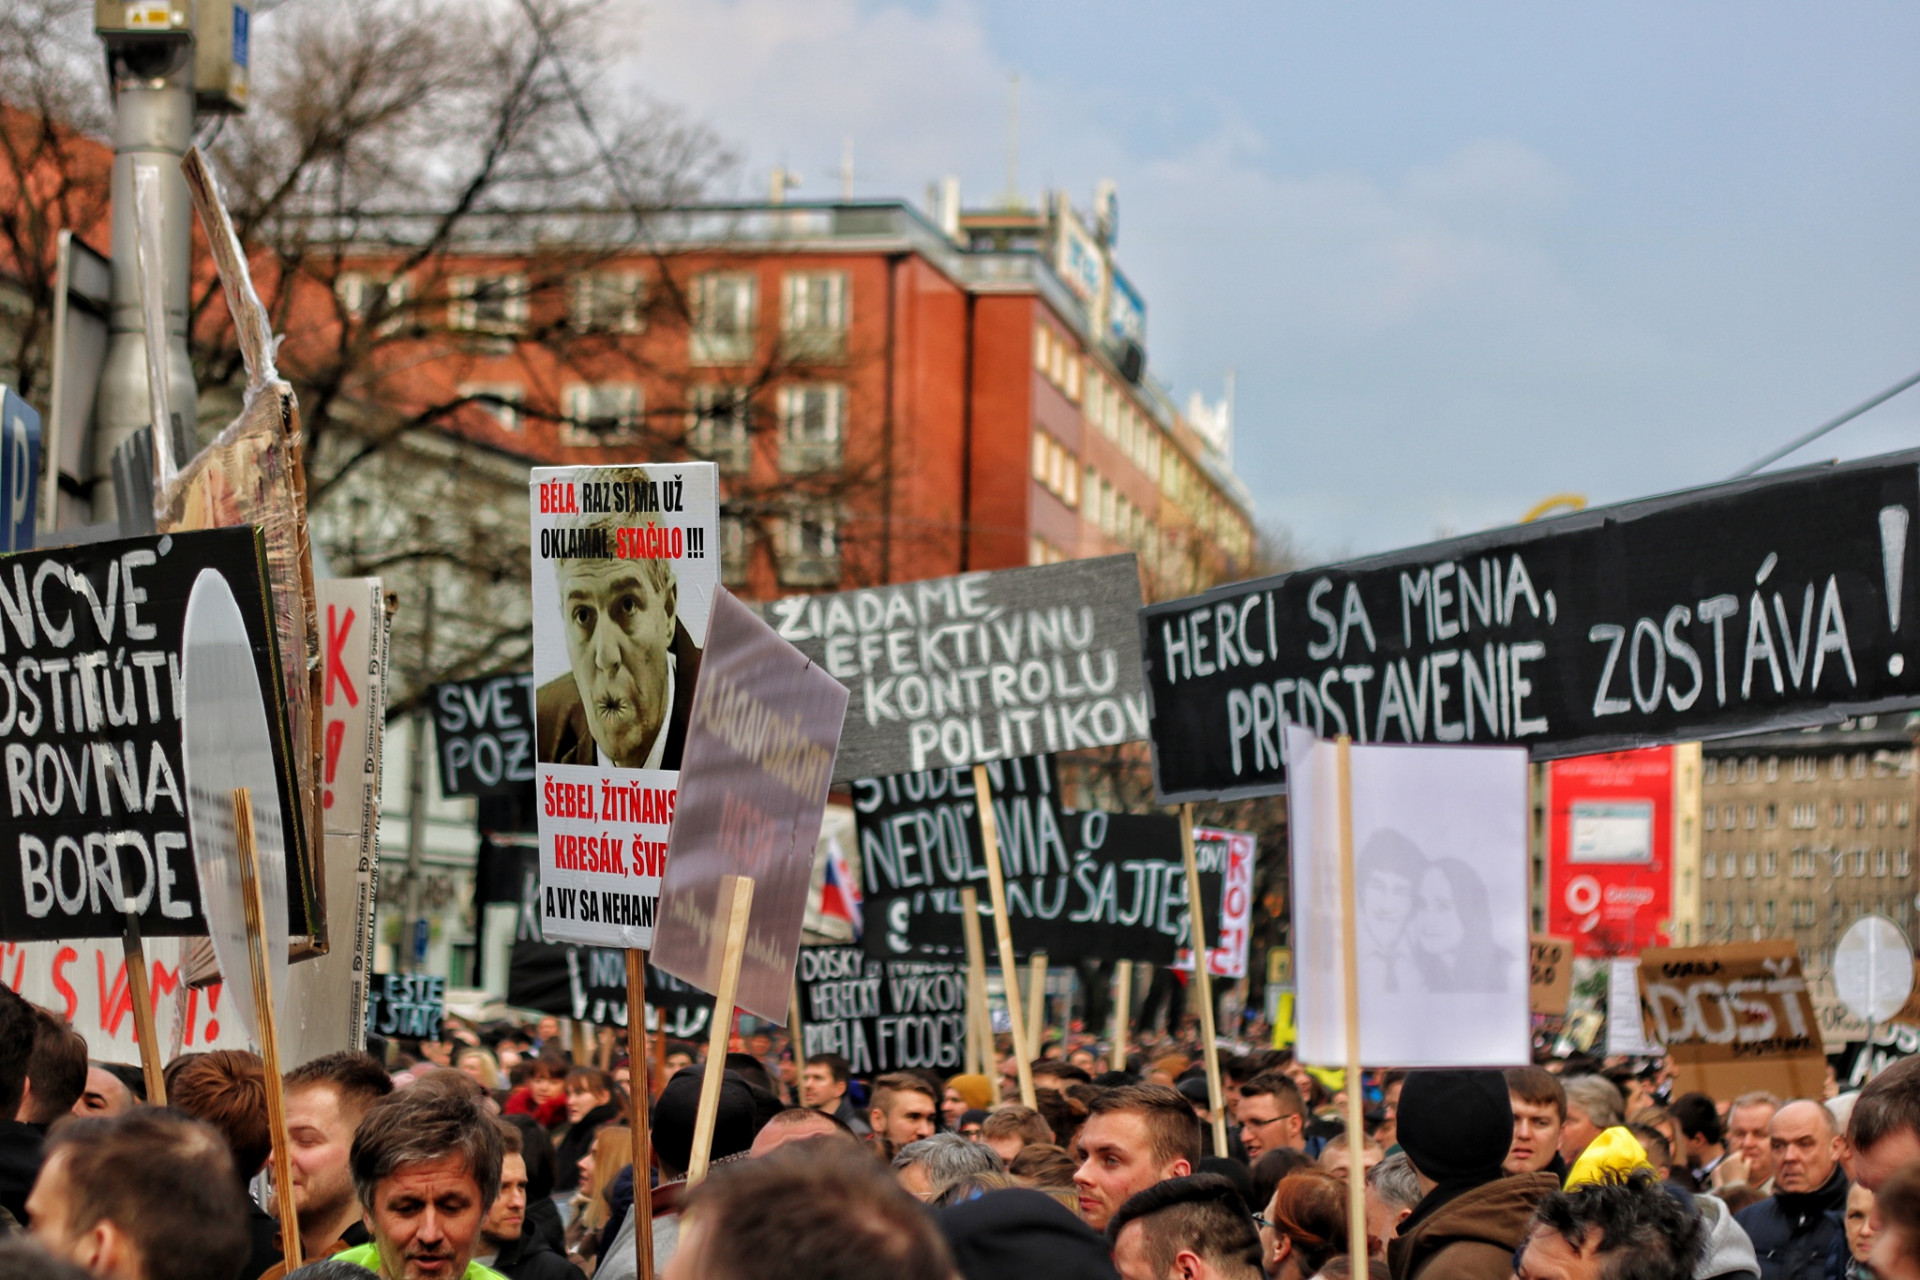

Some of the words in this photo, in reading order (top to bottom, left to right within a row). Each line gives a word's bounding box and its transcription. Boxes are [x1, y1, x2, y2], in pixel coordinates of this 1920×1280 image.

[540, 478, 579, 516] BÉLA,
[583, 482, 611, 513] RAZ
[613, 482, 630, 513] SI
[634, 481, 659, 513] MA
[663, 474, 683, 513] UŽ
[541, 528, 613, 562] OKLAMAL,
[616, 522, 683, 560] STAČILO
[687, 528, 704, 559] !!!
[772, 571, 992, 641] ŽIADAME
[1163, 590, 1279, 686] HERCI
[1307, 576, 1376, 661] SA
[1401, 552, 1557, 649] MENIA,
[1227, 640, 1549, 777] PREDSTAVENIE
[1589, 551, 1857, 718] ZOSTÁVA
[1878, 504, 1909, 677] !
[826, 605, 1096, 678] EFEKTÍVNU
[864, 649, 1118, 727] KONTROLU
[909, 690, 1149, 772] POLITIKOV
[544, 775, 598, 823] ŠEBEJ,
[554, 831, 628, 878] KRESÁK,
[546, 886, 555, 917] A
[557, 887, 576, 920] VY
[580, 889, 599, 922] SA
